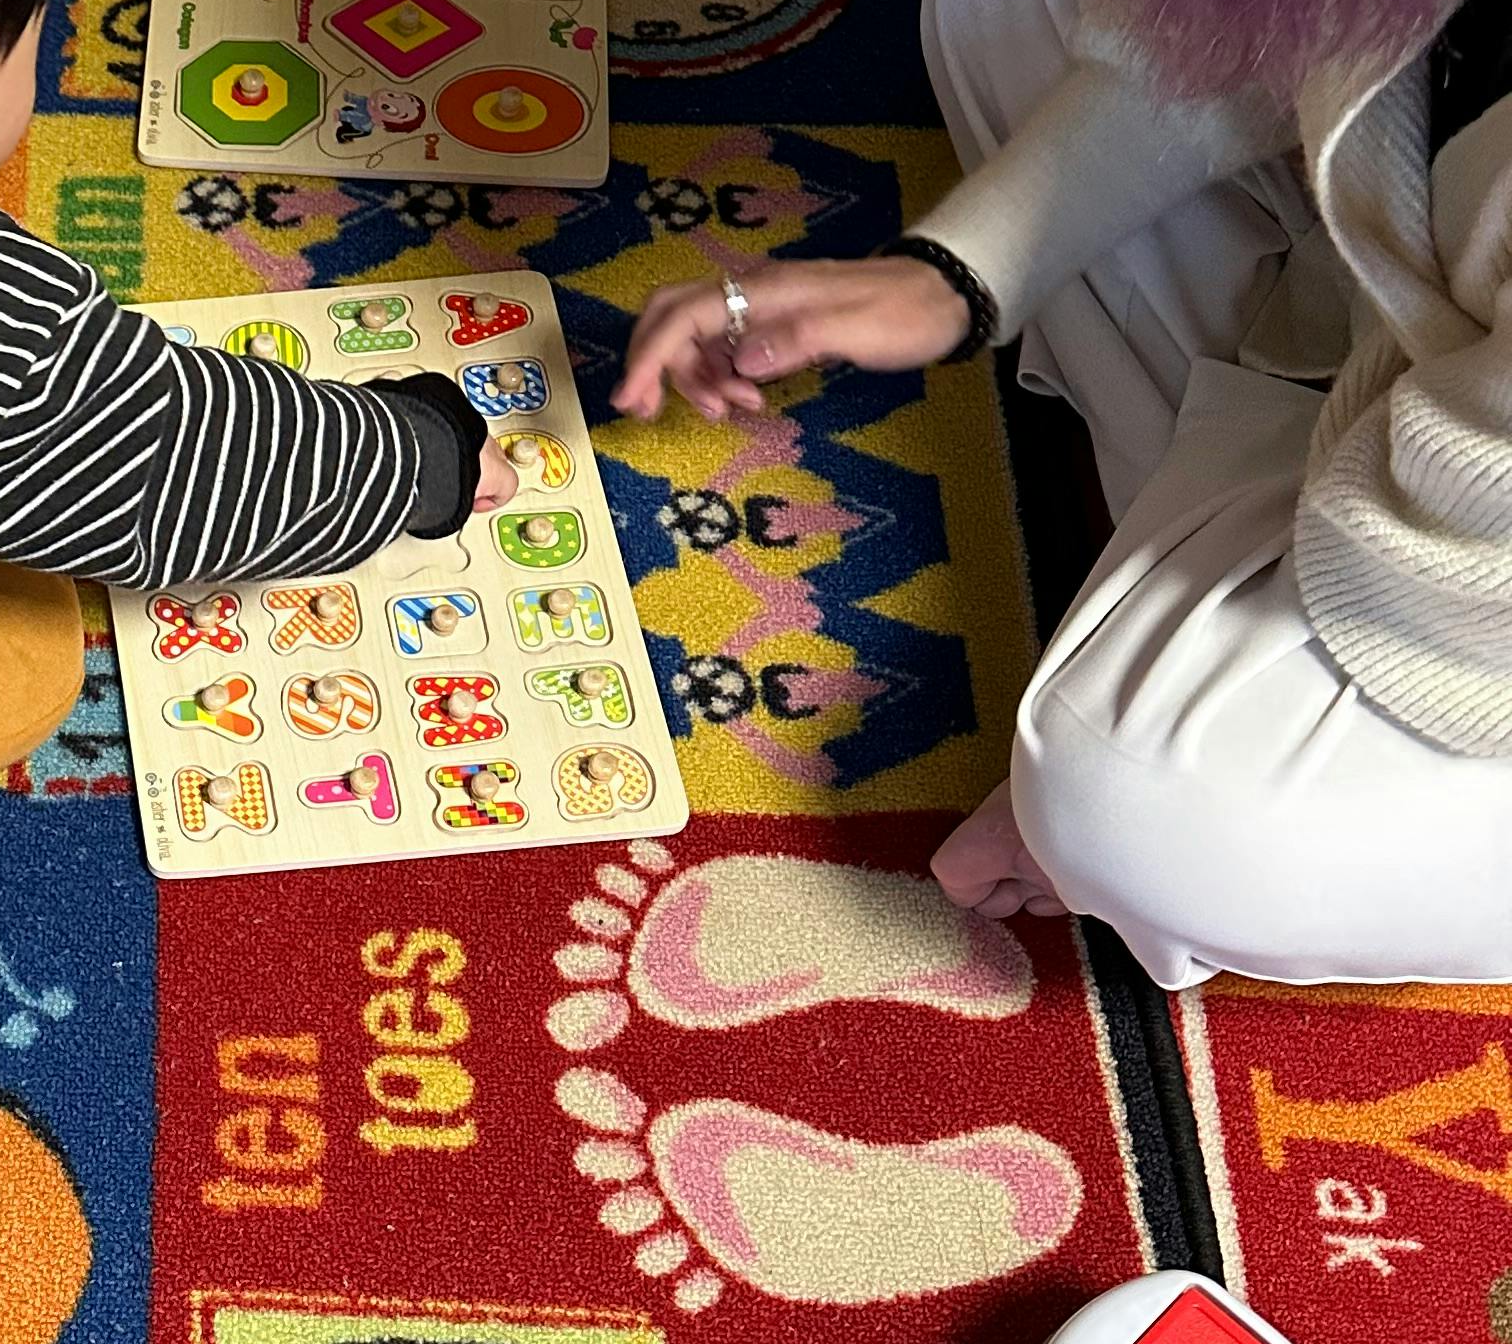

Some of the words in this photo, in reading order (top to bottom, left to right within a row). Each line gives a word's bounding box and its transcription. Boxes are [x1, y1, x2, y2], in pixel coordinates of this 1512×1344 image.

[177, 1, 197, 50] Octagon
[700, 2, 748, 22] 8
[424, 132, 441, 161] Oval
[445, 293, 530, 348] A
[462, 360, 547, 417] B
[495, 432, 571, 489] C
[497, 511, 583, 568] D
[153, 593, 243, 659] X
[265, 582, 356, 651] R
[391, 592, 478, 655] L
[513, 584, 609, 648] E
[172, 676, 256, 737] Y
[287, 673, 377, 736] S
[413, 675, 504, 747] M
[530, 665, 631, 724] F
[175, 762, 269, 833] Z
[304, 754, 396, 820] T
[434, 760, 526, 829] H
[558, 747, 649, 817] G
[357, 925, 479, 1155] toes
[200, 1031, 328, 1214] ten
